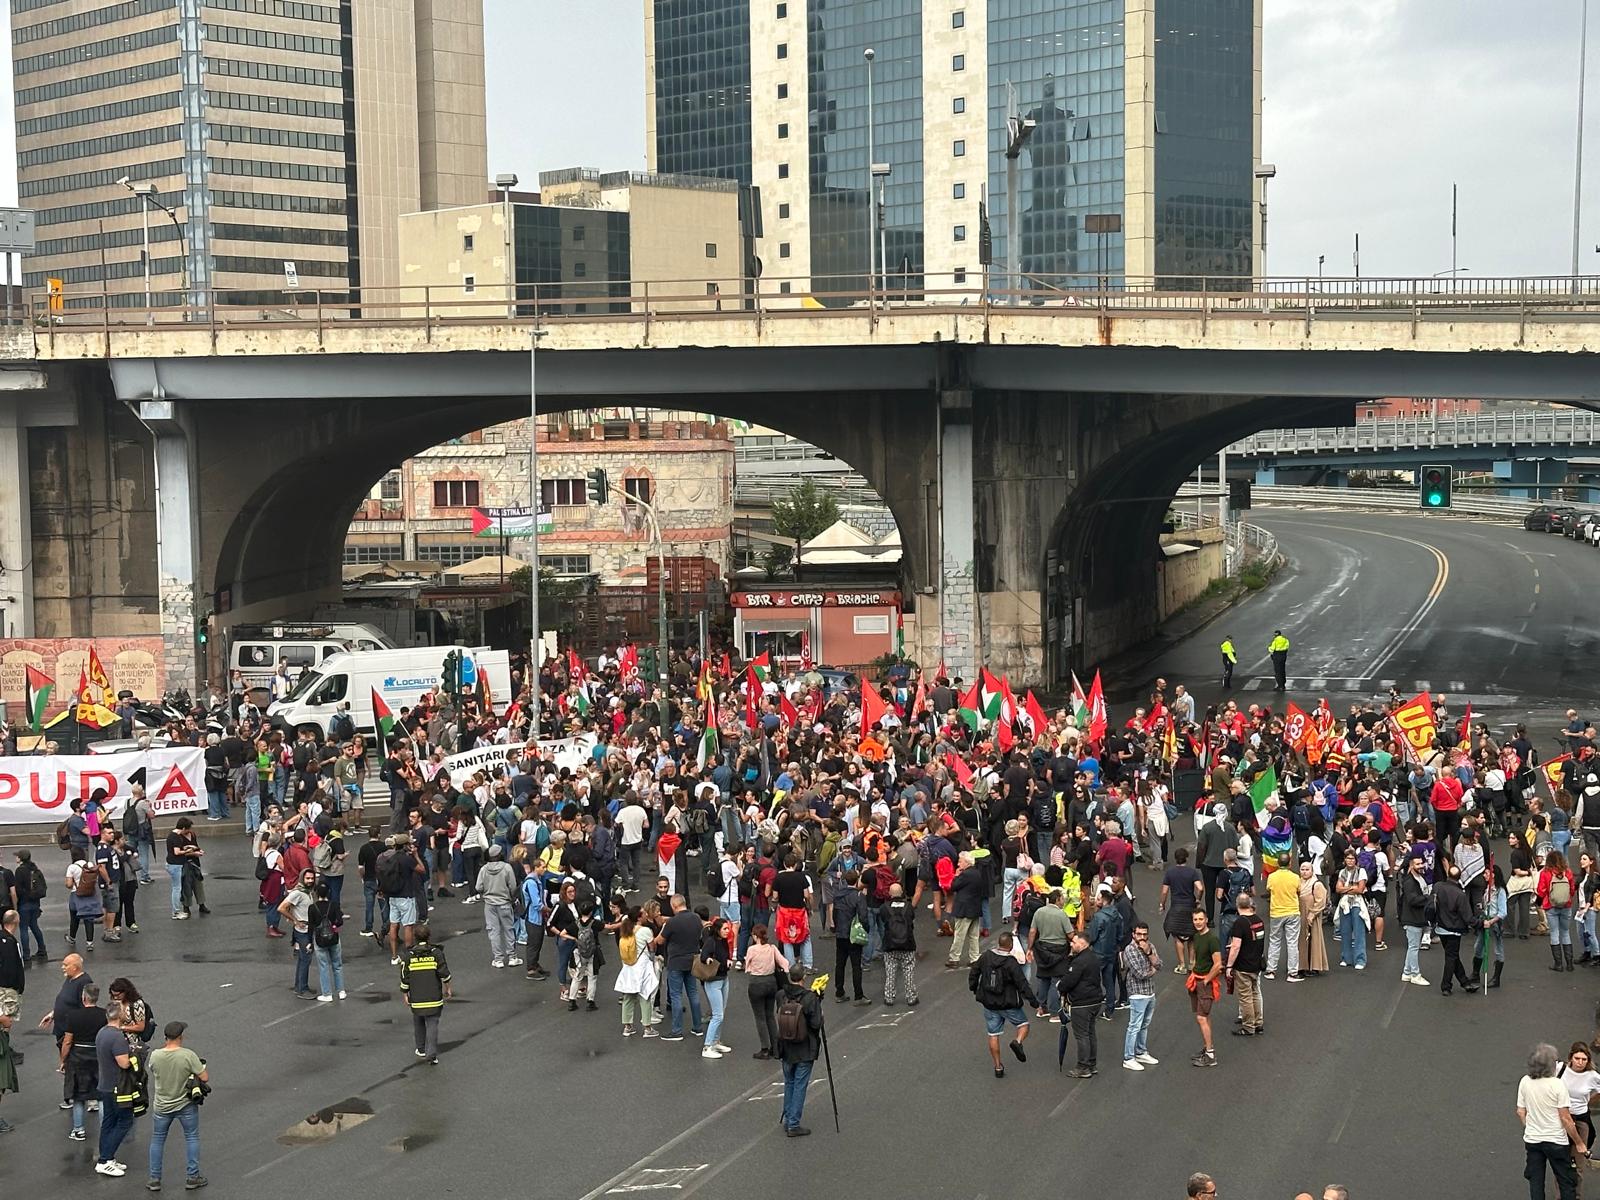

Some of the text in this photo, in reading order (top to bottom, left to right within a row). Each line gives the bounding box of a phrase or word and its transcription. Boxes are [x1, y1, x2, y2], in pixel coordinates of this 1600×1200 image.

[745, 594, 773, 606] BAR
[396, 677, 437, 686] LOCAUTO
[449, 750, 505, 771] SANITARI
[152, 798, 198, 811] UERRA
